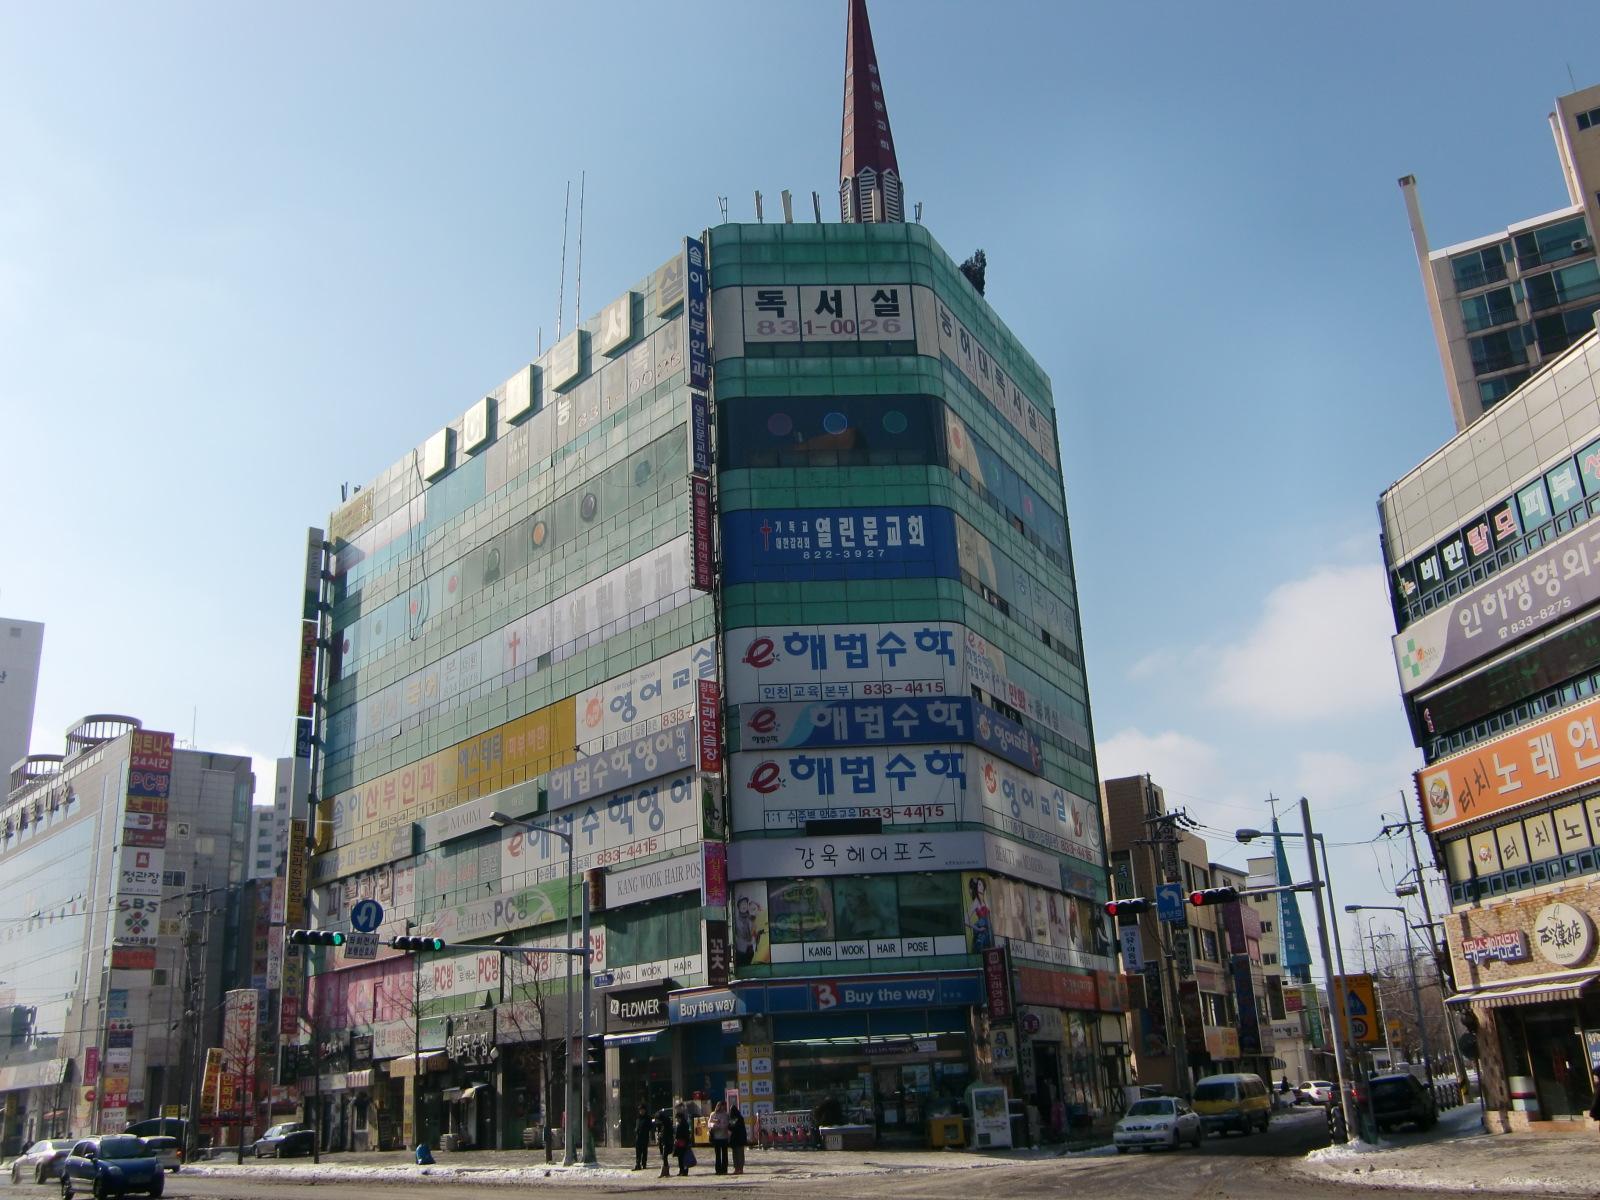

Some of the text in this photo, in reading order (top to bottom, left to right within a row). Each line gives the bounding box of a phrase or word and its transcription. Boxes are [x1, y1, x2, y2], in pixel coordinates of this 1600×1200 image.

[754, 288, 901, 318] 독서실
[756, 318, 902, 337] 831-0026
[775, 521, 809, 534] 기독교
[815, 514, 925, 548] 열린문교회
[1419, 467, 1576, 582] 비만 탈모 피부
[803, 549, 886, 560] 822-3927
[1510, 596, 1572, 633] 833-8275
[783, 627, 956, 671] 해법수학
[609, 640, 717, 723] 영어교실
[763, 681, 945, 699] 인천 교육 본부 833-4415
[701, 697, 719, 761] 노래연습장
[810, 700, 965, 741] 해법수학
[130, 770, 170, 793] PC방
[550, 733, 675, 802] 해법수학영어
[789, 750, 967, 796] 해법수학
[333, 762, 436, 829] 솔이산부인과
[1002, 776, 1067, 825] 영어교실
[861, 803, 945, 819] 833-4415
[597, 838, 658, 866] 833-4415
[795, 841, 936, 870] 강욱헤어포즈
[122, 870, 160, 885] 정관장
[616, 876, 638, 897] KANG
[640, 873, 662, 893] WOOK
[663, 868, 683, 888] HAIR
[119, 898, 159, 913] SBS
[494, 894, 528, 927] PC방
[808, 942, 929, 958] KANG WOOK HAIR POSE
[434, 963, 454, 991] PC방
[478, 954, 499, 984] PC방
[613, 969, 631, 982] ANG
[641, 965, 662, 977] WOOK
[673, 960, 692, 973] HAIR
[620, 998, 659, 1018] FLOWER
[680, 998, 735, 1017] Buy the way
[845, 988, 935, 1005] Buy the way
